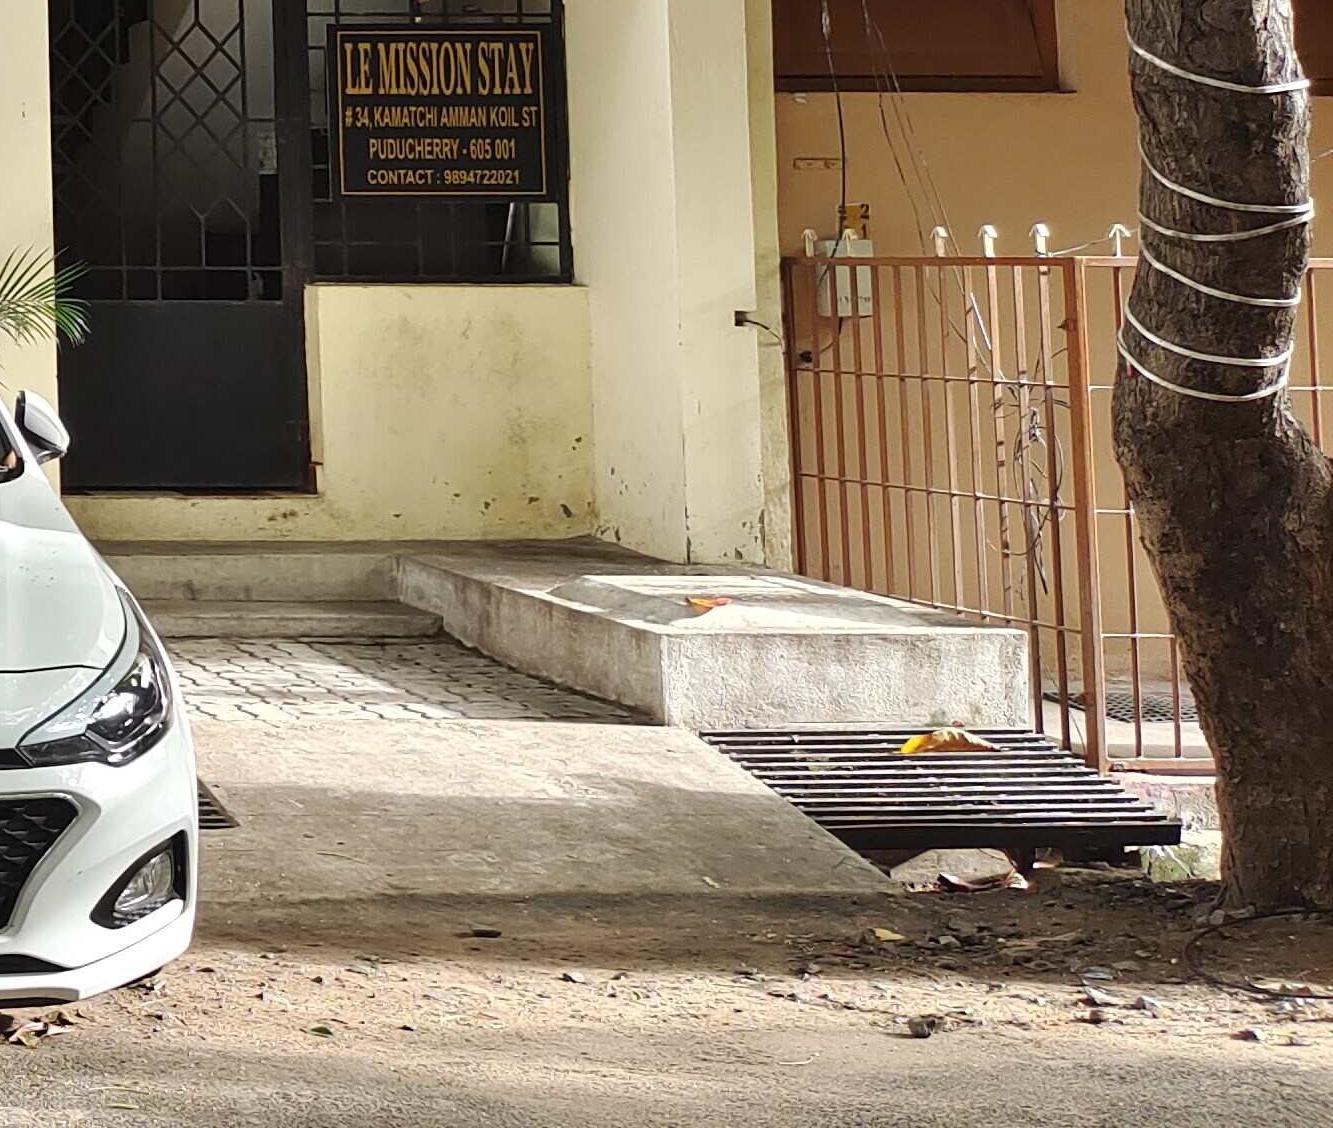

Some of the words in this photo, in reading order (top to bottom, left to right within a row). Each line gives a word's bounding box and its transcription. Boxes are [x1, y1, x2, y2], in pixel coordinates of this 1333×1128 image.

[344, 42, 373, 94] LE
[377, 41, 472, 96] MISSION
[477, 41, 534, 96] STAY
[345, 106, 353, 127] #
[374, 106, 438, 127] KAMATCHI
[440, 106, 487, 127] AMMAN
[490, 106, 519, 127] KOIL
[521, 106, 538, 127] ST
[368, 138, 460, 159] PUDUCHERRY
[469, 138, 492, 159] 605
[495, 138, 516, 159] 001
[367, 169, 434, 185] CONTACT
[443, 169, 520, 185] 9894722021
